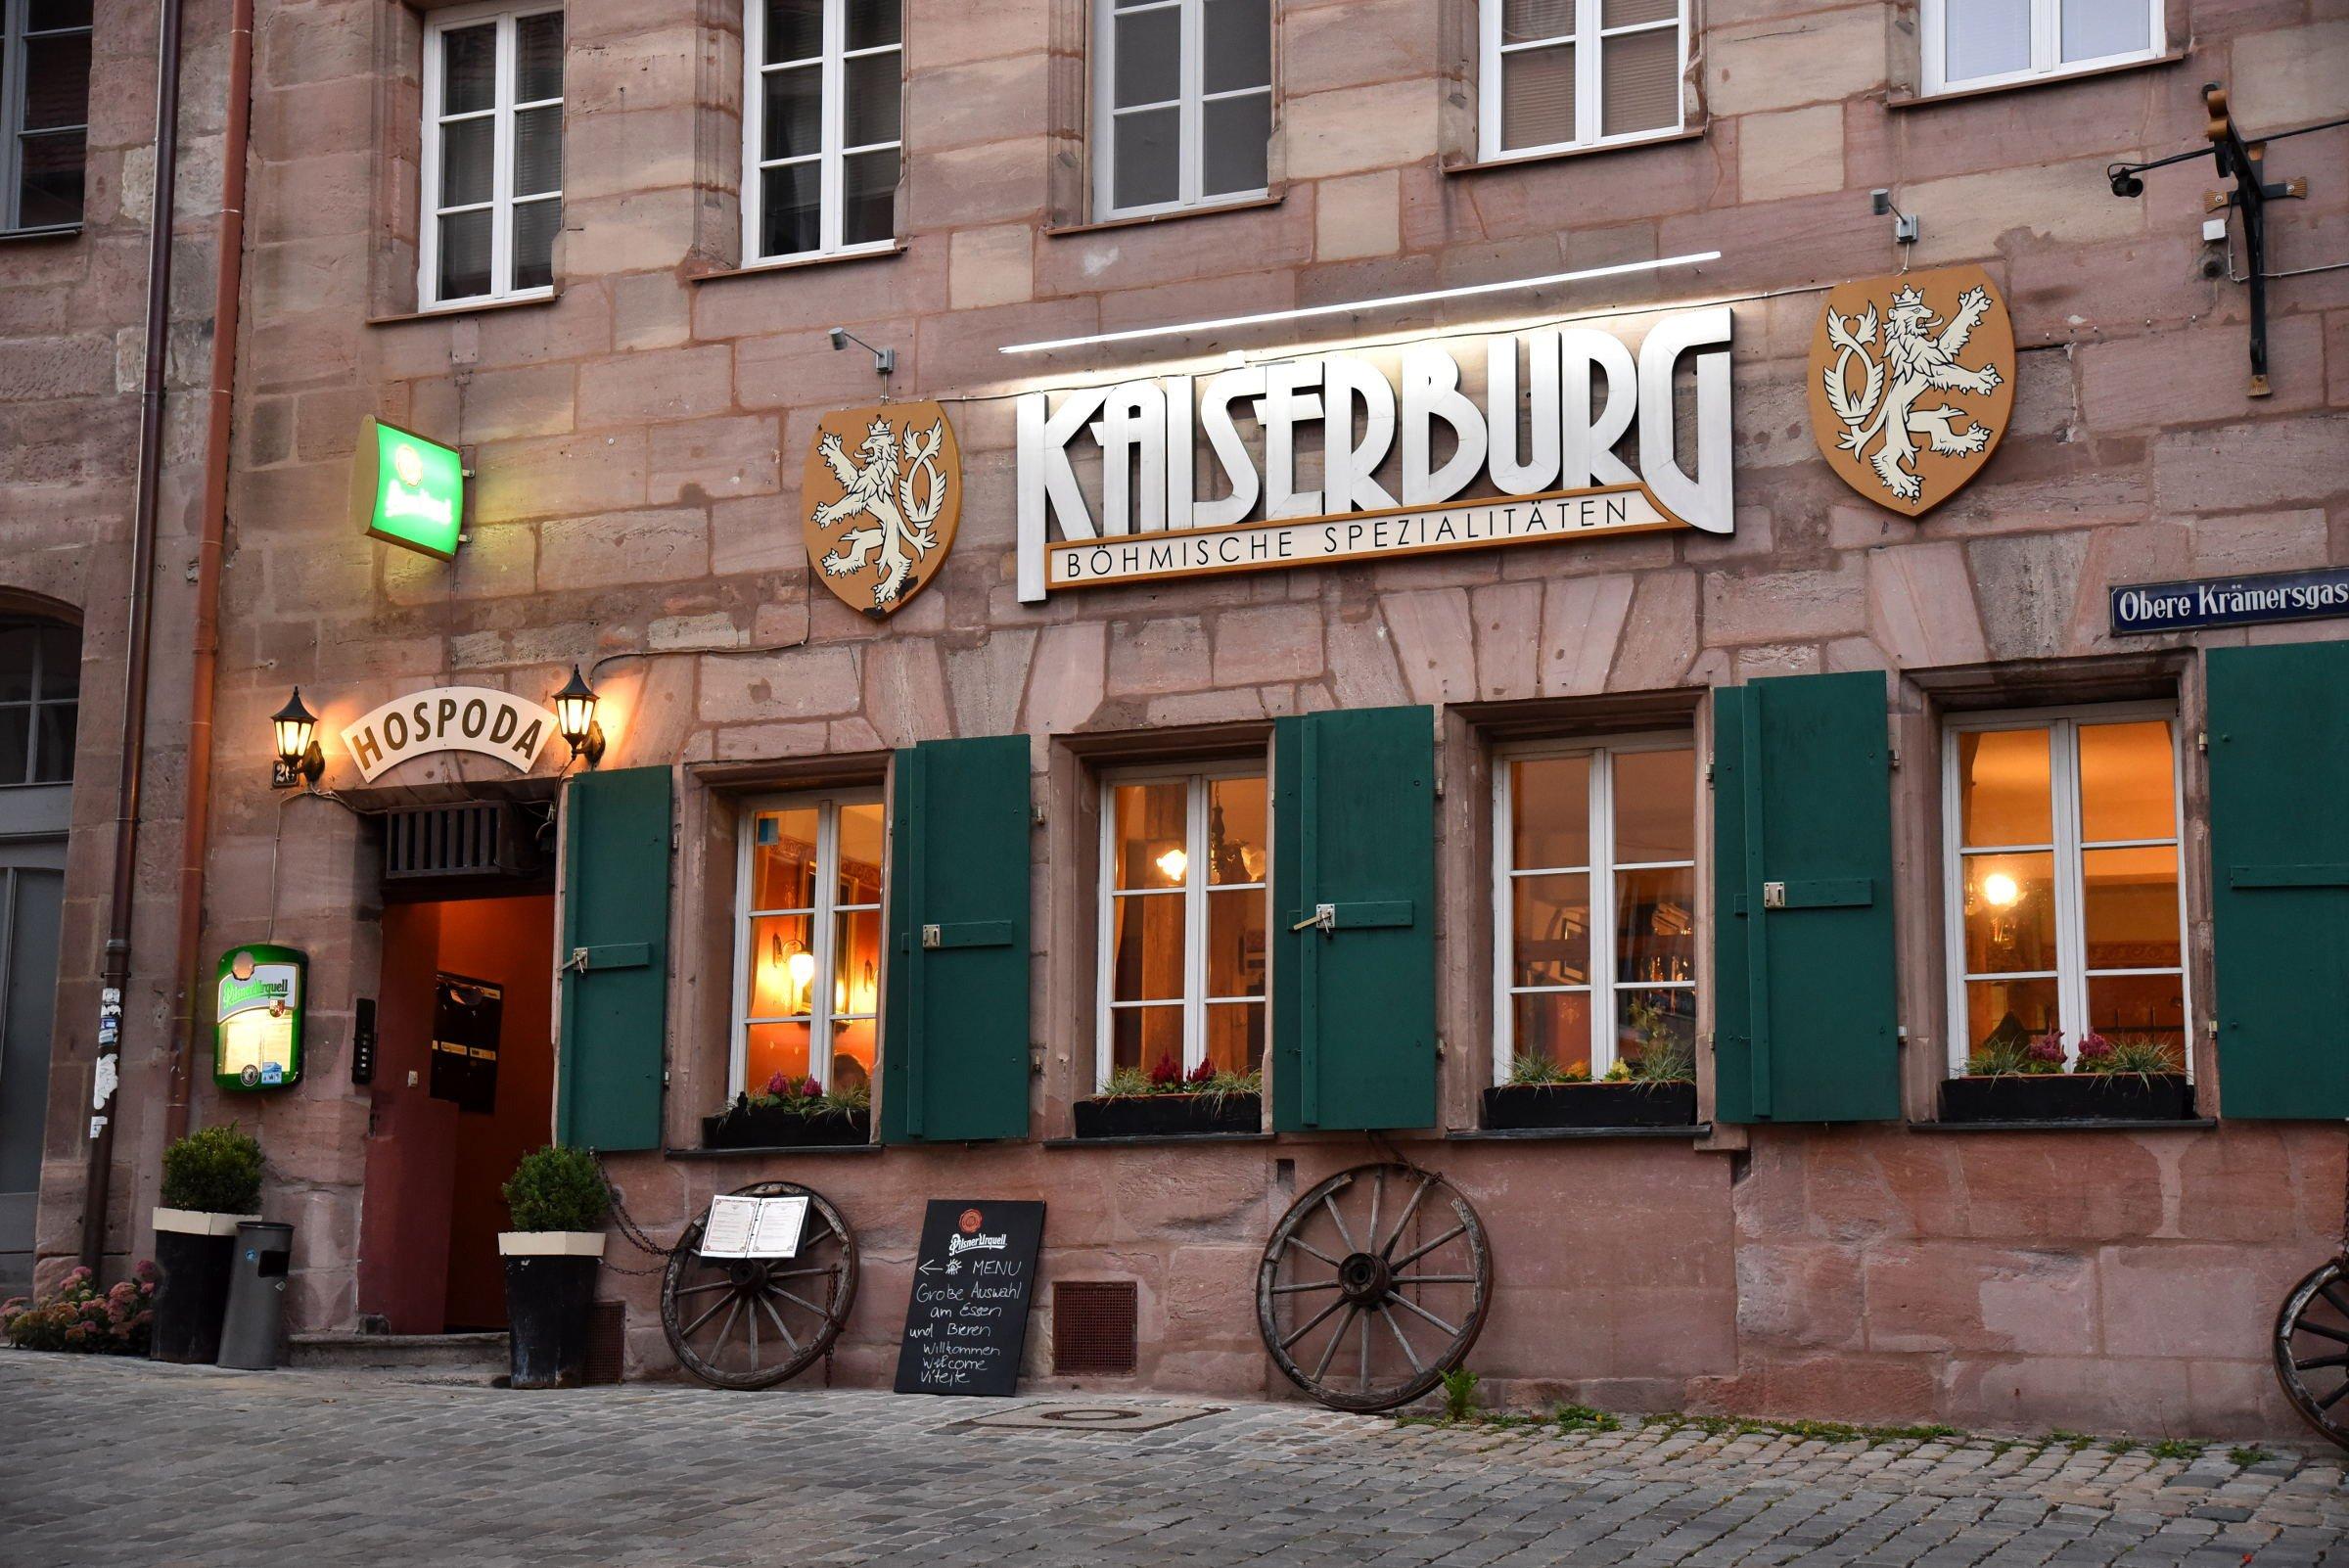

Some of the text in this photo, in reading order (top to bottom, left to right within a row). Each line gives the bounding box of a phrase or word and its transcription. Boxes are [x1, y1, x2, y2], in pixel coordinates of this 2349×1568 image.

[1017, 306, 1734, 603] KAISERBURG
[1068, 497, 1627, 577] BÖHMISCHE SPEZIALITÄTEN
[2119, 590, 2191, 622] Obere
[351, 698, 543, 771] HOSPODA
[948, 1233, 1007, 1256] Pilsner Urquell
[972, 1260, 1022, 1276] MENU
[970, 1281, 1022, 1300] Auswahl
[930, 1302, 1002, 1318] am Essen
[909, 1322, 990, 1339] und Bieren
[923, 1341, 1000, 1357] Willkommen
